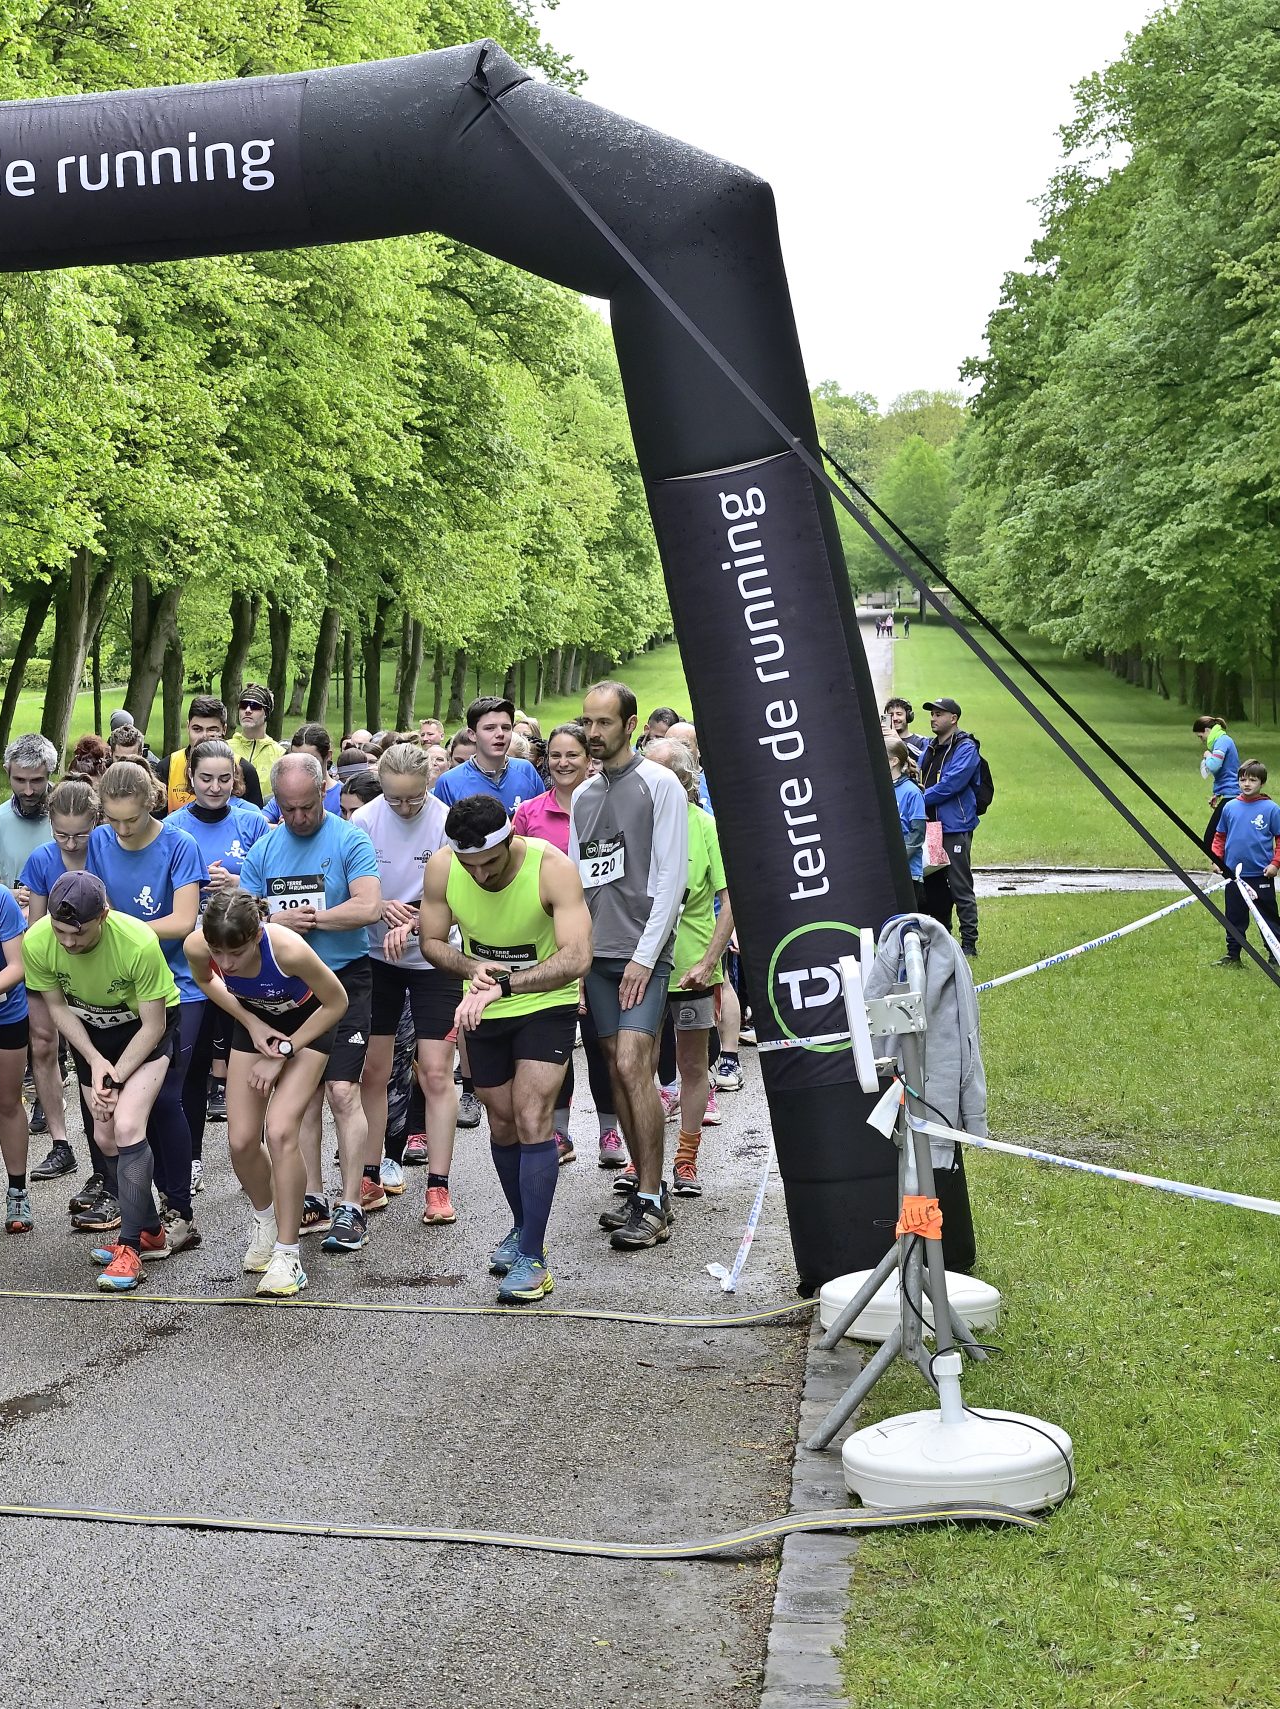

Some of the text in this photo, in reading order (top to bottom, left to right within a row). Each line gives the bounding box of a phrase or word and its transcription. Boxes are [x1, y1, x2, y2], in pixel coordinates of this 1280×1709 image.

[57, 131, 276, 194] running
[718, 486, 831, 901] terre de running
[590, 857, 616, 878] 220
[778, 964, 842, 1010] TD
[83, 1013, 121, 1025] 214
